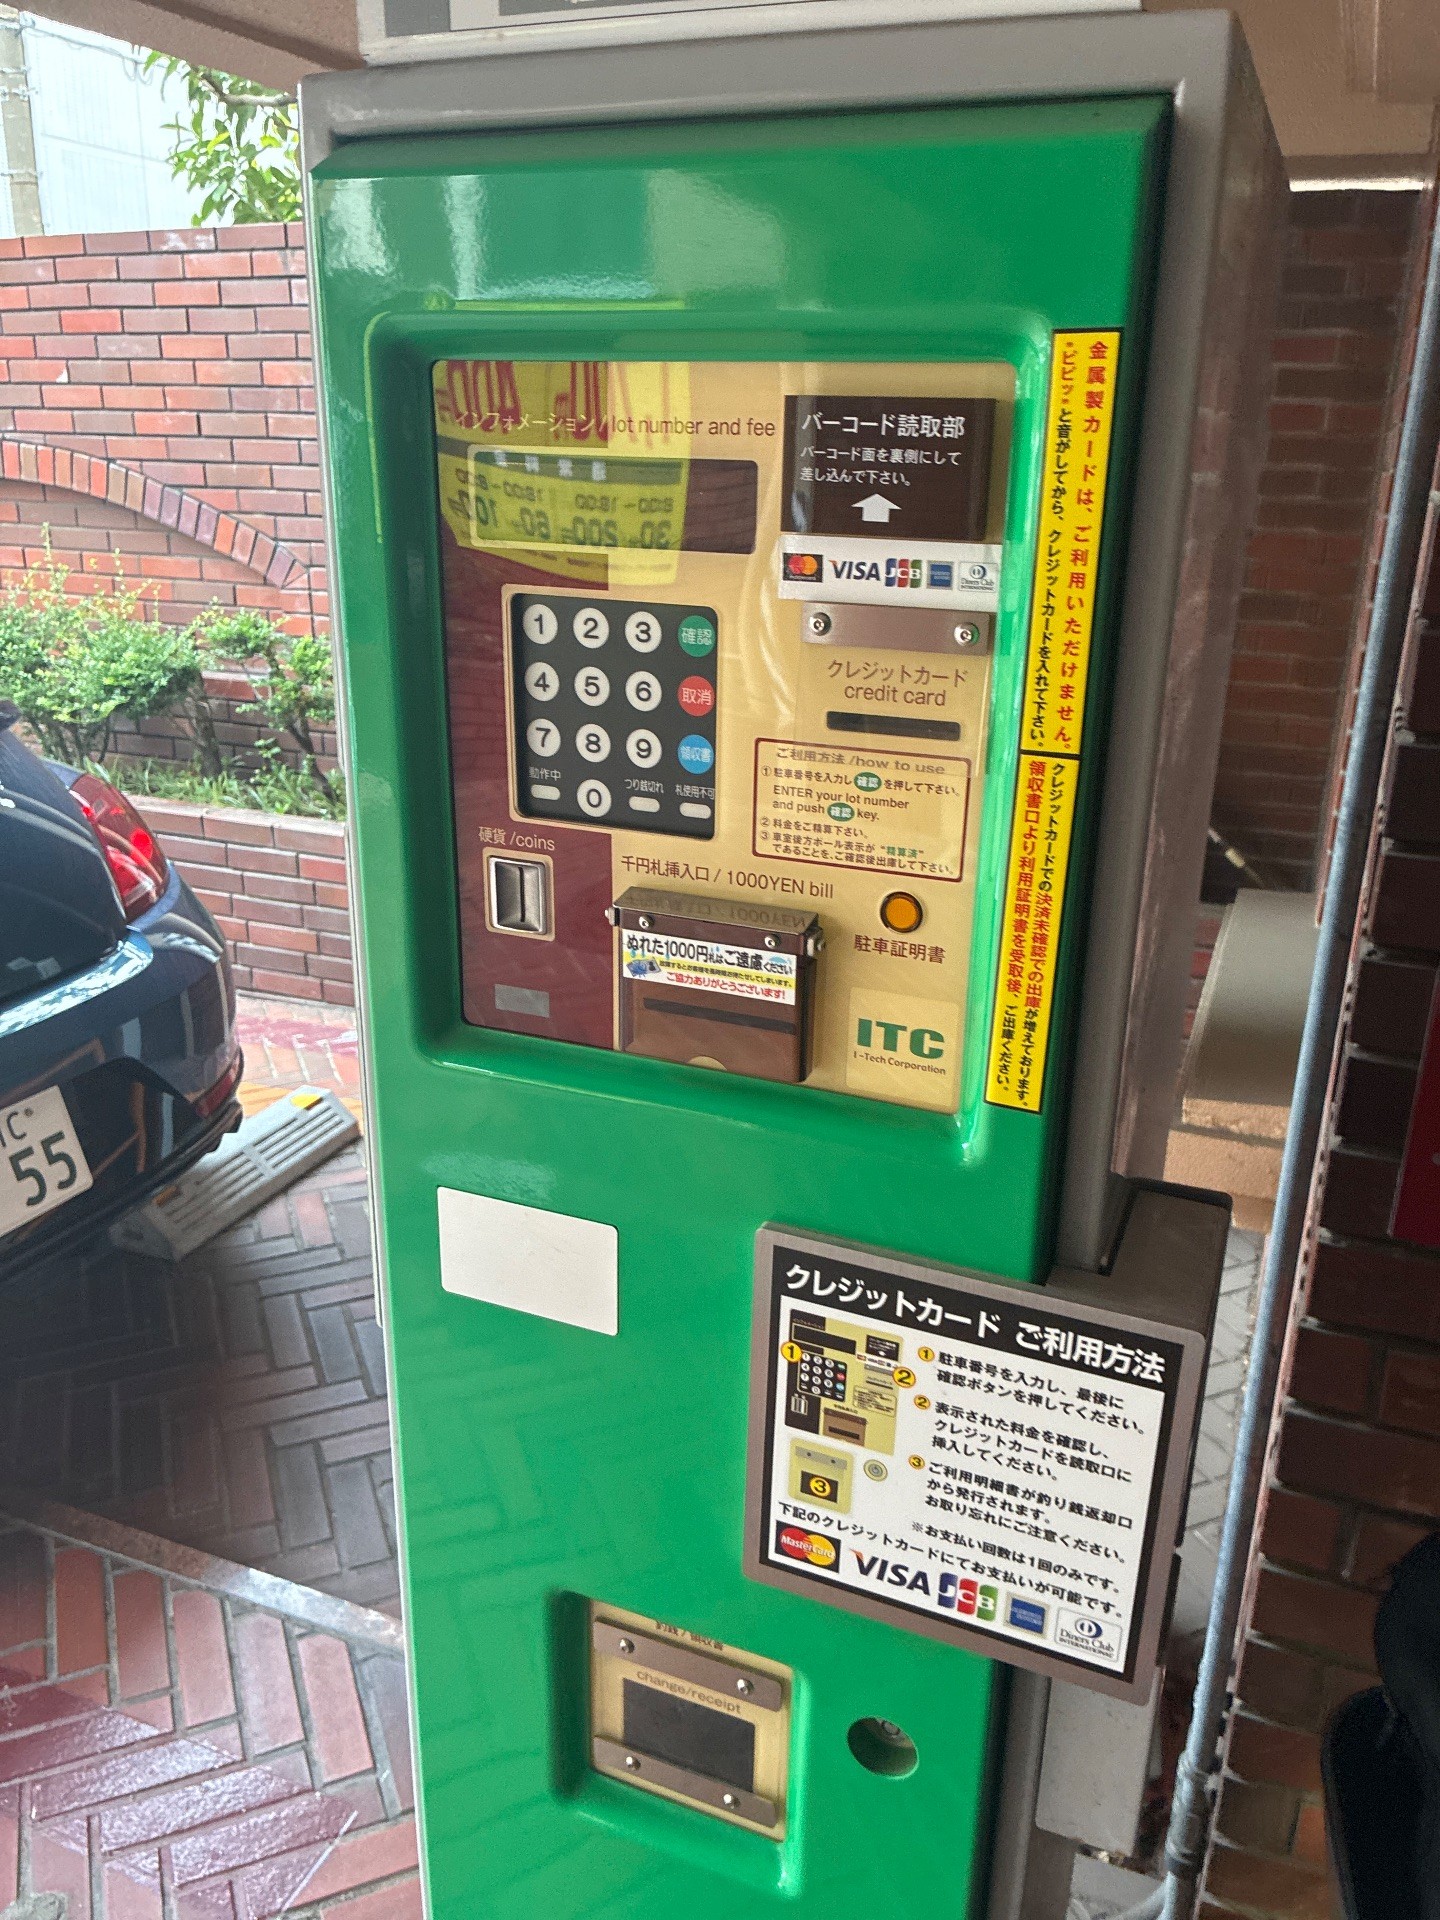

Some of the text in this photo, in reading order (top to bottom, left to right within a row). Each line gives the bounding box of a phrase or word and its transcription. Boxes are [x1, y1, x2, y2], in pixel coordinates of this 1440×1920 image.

[639, 416, 702, 436] number
[708, 417, 741, 436] and
[746, 416, 776, 436] fee
[801, 411, 966, 439] バーコード読取部
[800, 446, 962, 466] バーコード面を裏側にして
[800, 466, 911, 487] 差し込んで下さい。
[1054, 340, 1109, 749] 金属製カードは、ご利用いただけません。
[829, 558, 923, 588] VISA JCB
[534, 614, 713, 646] 1 2 3 確認
[534, 672, 713, 706] 4 5 6 取消
[828, 659, 969, 688] クレジットカード
[844, 684, 946, 706] credit card
[535, 727, 712, 763] 7 8 9 領収書
[776, 748, 846, 765] ご利用方法
[895, 757, 910, 771] to
[914, 763, 945, 775] use
[586, 788, 602, 809] 0
[675, 784, 716, 800] 札使用不可
[773, 767, 853, 785] 駐車番号を入力し
[856, 776, 880, 789] 確認
[884, 779, 960, 797] を押して下さい。
[773, 784, 910, 810] ENTER your lot number
[772, 800, 880, 822] and push 確認 key.
[478, 826, 506, 845] 硬貨
[621, 855, 709, 882] 千円札挿入口
[727, 870, 805, 895] 1000YEN
[809, 880, 834, 899] bill
[855, 934, 946, 964] 駐車証明書
[857, 1018, 945, 1059] ITC
[888, 1057, 946, 1075] Corporation
[9, 1130, 78, 1207] 55
[786, 1263, 1166, 1385] クレジットカード ご利用方法
[936, 1368, 1144, 1435] 確認ボタンを押してください。
[935, 1401, 1109, 1459] 表示された料金を確認し、
[932, 1435, 1058, 1481] 挿入してください。
[934, 1419, 1132, 1483] クレジットカードを読取口に
[927, 1478, 1051, 1524] から発行されます。
[929, 1461, 1133, 1530] ご利用明細書が釣り銭返却口
[925, 1494, 1125, 1563] お取り忘れにご注意ください。
[779, 1502, 1122, 1619] 下記のクレジットカードにてお支払いが可能です。
[780, 1533, 836, 1558] MasterCard
[850, 1549, 931, 1596] VISA
[937, 1572, 999, 1621] JCB
[1060, 1629, 1115, 1653] Diners Club
